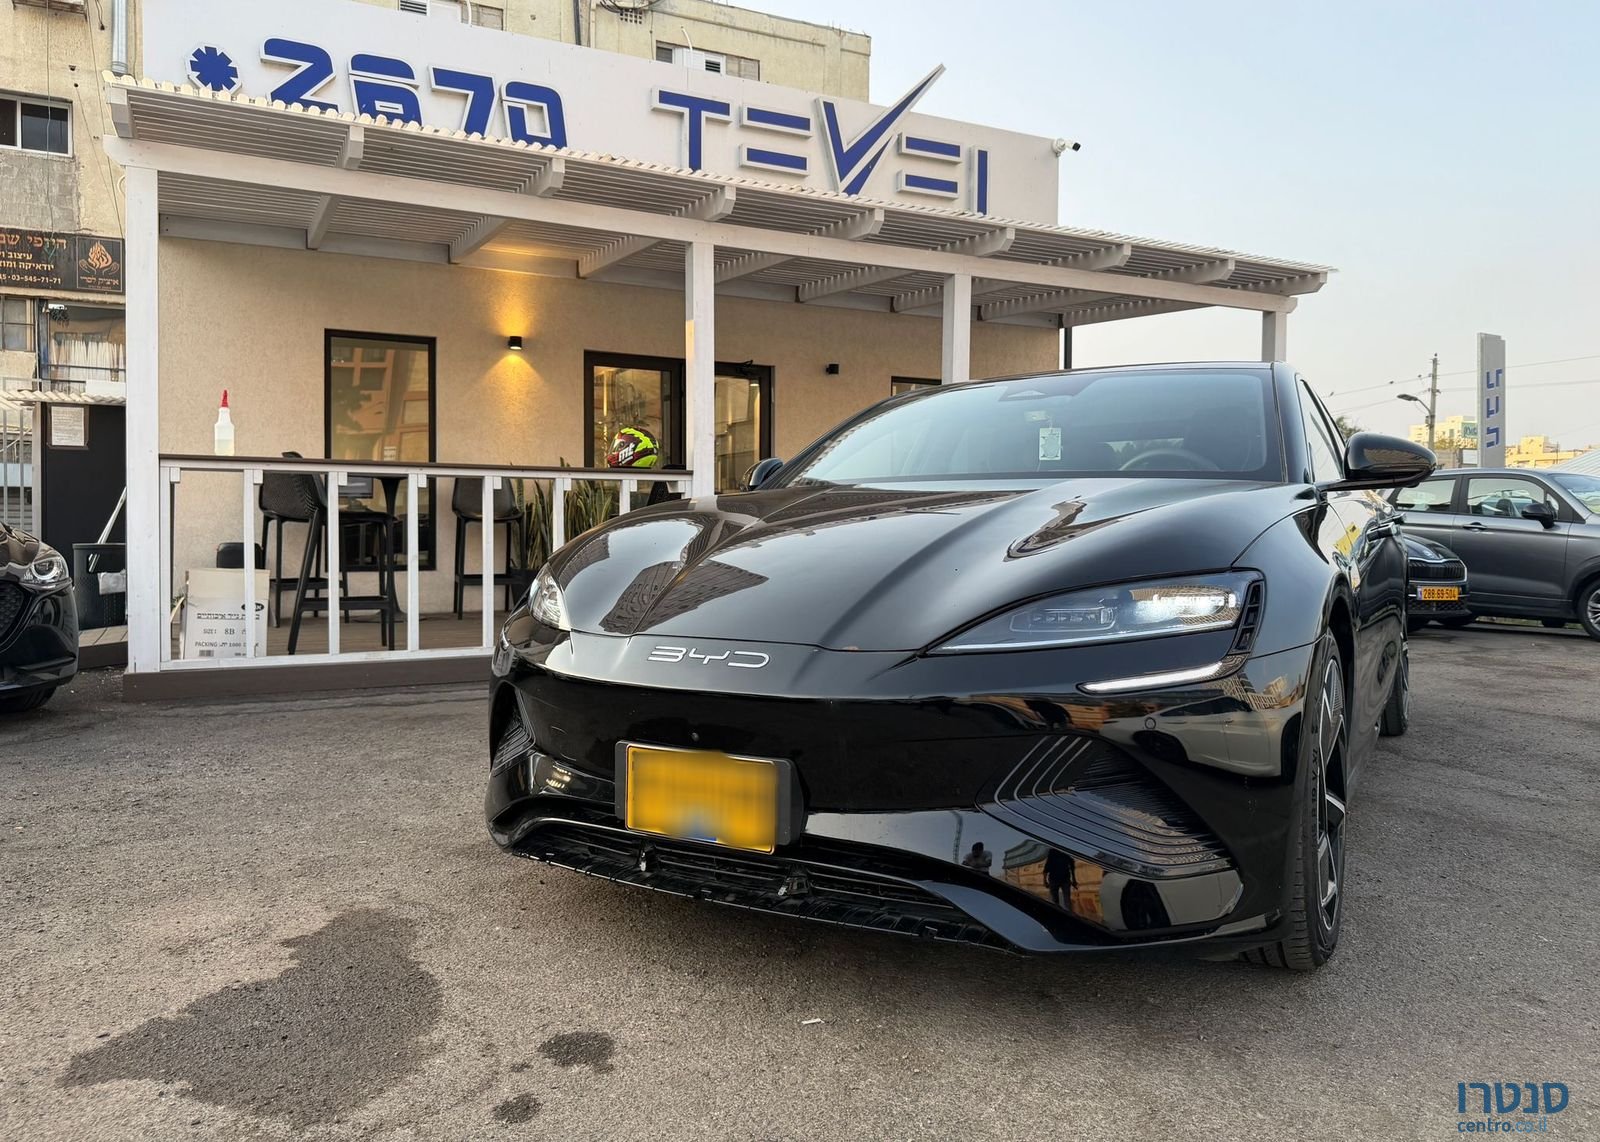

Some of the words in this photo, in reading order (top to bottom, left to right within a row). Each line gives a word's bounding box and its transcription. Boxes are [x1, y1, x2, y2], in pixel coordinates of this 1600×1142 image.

[7, 251, 33, 260] עיצוב
[18, 261, 55, 271] יודאיקה
[648, 645, 770, 668] BYD
